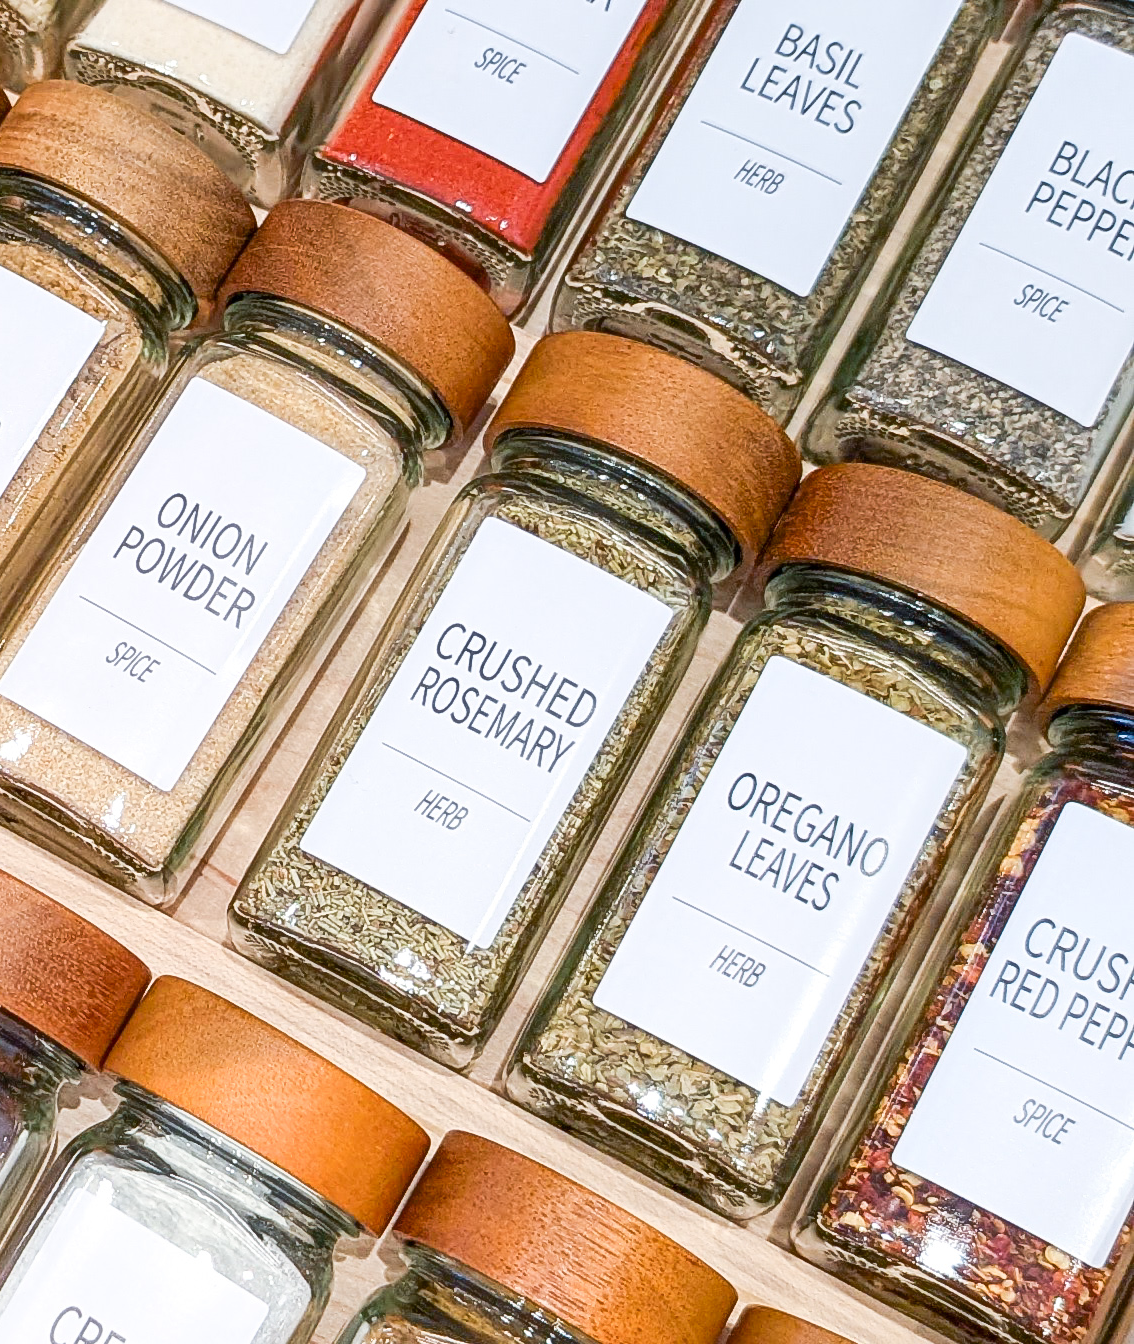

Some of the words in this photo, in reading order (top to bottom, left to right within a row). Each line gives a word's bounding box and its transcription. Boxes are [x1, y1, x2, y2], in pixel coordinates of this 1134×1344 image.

[474, 47, 527, 84] SPICE
[775, 24, 864, 88] BASIL
[740, 58, 862, 134] LEAVES
[734, 161, 785, 194] HERB
[1049, 141, 1134, 210] BLAC
[1025, 181, 1134, 261] PEPPE
[1014, 284, 1069, 322] SPICE
[157, 493, 268, 575] ONION
[114, 526, 254, 630] POWDER
[106, 642, 161, 682] SPICE
[437, 623, 597, 728] CRUSHED
[410, 667, 575, 773] ROSEMARY
[414, 789, 468, 831] HERB
[728, 772, 889, 878] OREGANO
[730, 829, 839, 911] LEAVES
[708, 945, 766, 987] HERB
[991, 959, 1058, 1019] RED
[1013, 1098, 1077, 1145] SPICE
